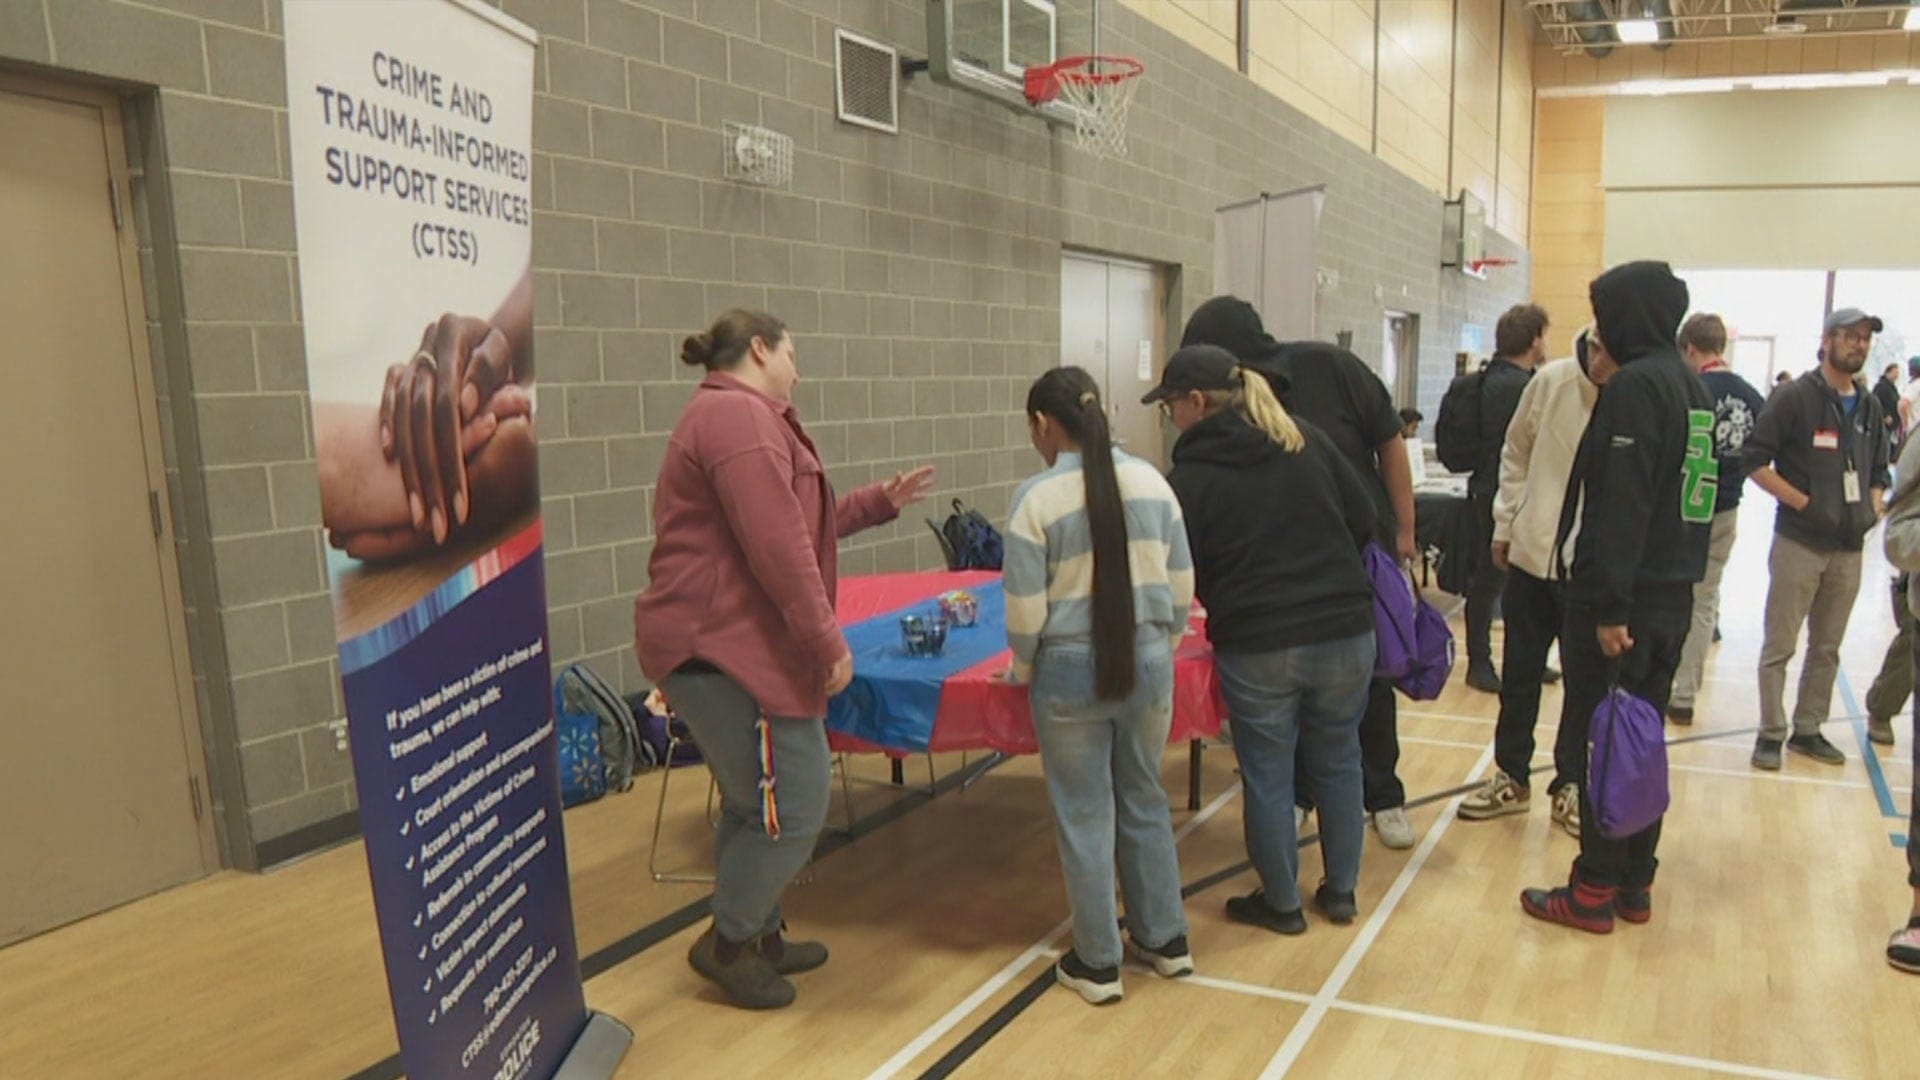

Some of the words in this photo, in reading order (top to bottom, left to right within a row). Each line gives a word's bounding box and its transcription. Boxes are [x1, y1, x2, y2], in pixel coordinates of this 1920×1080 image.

[372, 51, 443, 108] CRIME
[450, 82, 493, 124] AND
[316, 85, 529, 182] TRAUMA-INFORMED
[325, 147, 437, 205] SUPPORT
[444, 178, 529, 226] SERVICES
[413, 221, 478, 266] (CTSS)
[386, 709, 397, 731] If
[400, 704, 420, 729] you
[420, 692, 442, 715] have
[441, 681, 464, 702] been
[464, 676, 470, 691] a
[470, 662, 497, 687] victim
[497, 654, 506, 673] of
[507, 648, 529, 669] crime
[390, 728, 433, 759] trauma,
[432, 718, 445, 736] we
[445, 709, 461, 728] can
[461, 698, 480, 719] help
[410, 750, 455, 794] Emotional
[455, 730, 488, 763] support
[415, 796, 443, 827] Court
[485, 753, 501, 776] and
[421, 829, 451, 863] Access
[450, 821, 460, 838] to
[459, 809, 474, 829] the
[513, 764, 536, 789] Crime
